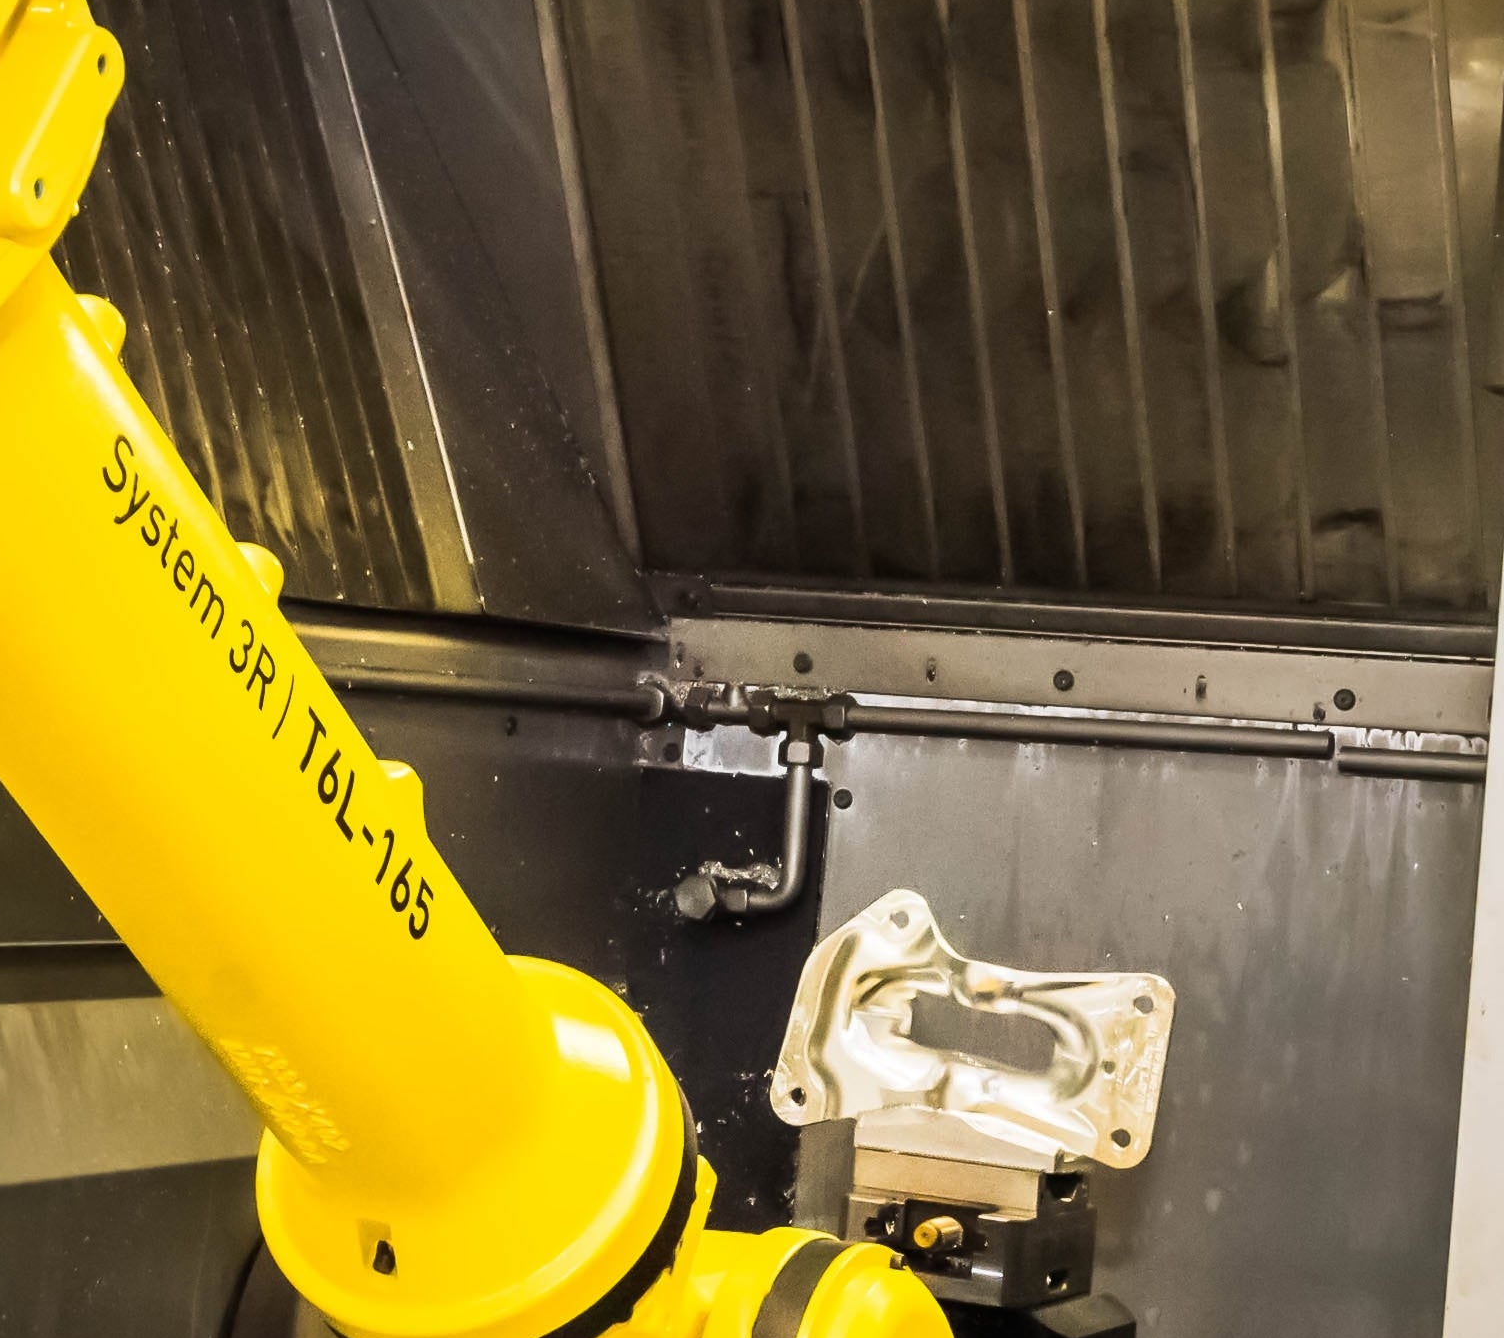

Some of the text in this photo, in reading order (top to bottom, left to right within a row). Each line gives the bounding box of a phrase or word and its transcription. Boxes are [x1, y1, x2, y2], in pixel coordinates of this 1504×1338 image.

[102, 433, 226, 640] System
[228, 619, 277, 712] 3R
[300, 706, 434, 940] T6L-165
